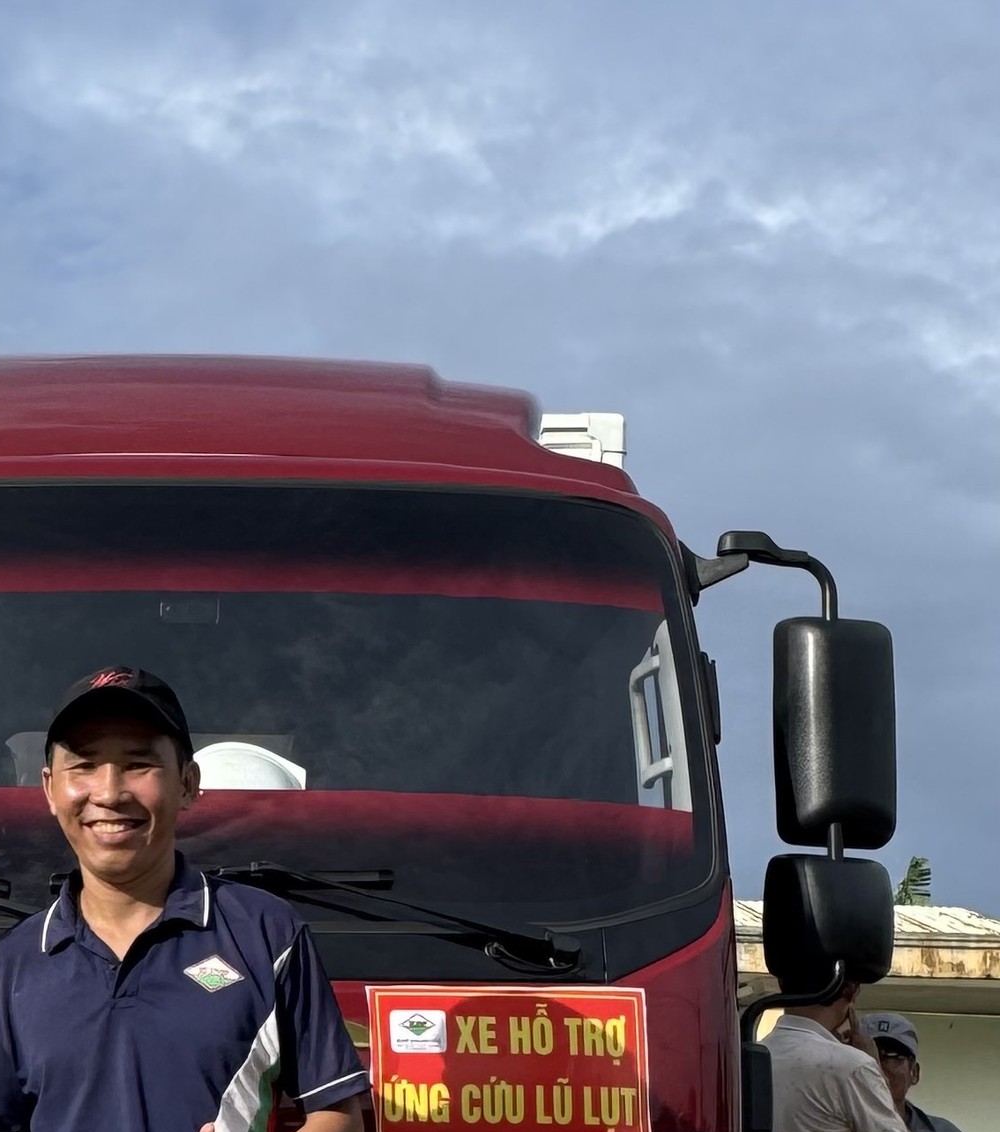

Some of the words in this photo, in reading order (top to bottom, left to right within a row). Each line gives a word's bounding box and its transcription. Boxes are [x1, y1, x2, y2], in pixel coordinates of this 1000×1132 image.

[456, 1015, 498, 1054] XE
[510, 1003, 554, 1055] HỖ
[564, 1015, 626, 1066] TRỢ
[383, 1074, 450, 1123] ỨNG
[461, 1076, 525, 1124] CỨU
[536, 1078, 573, 1125] LŨ
